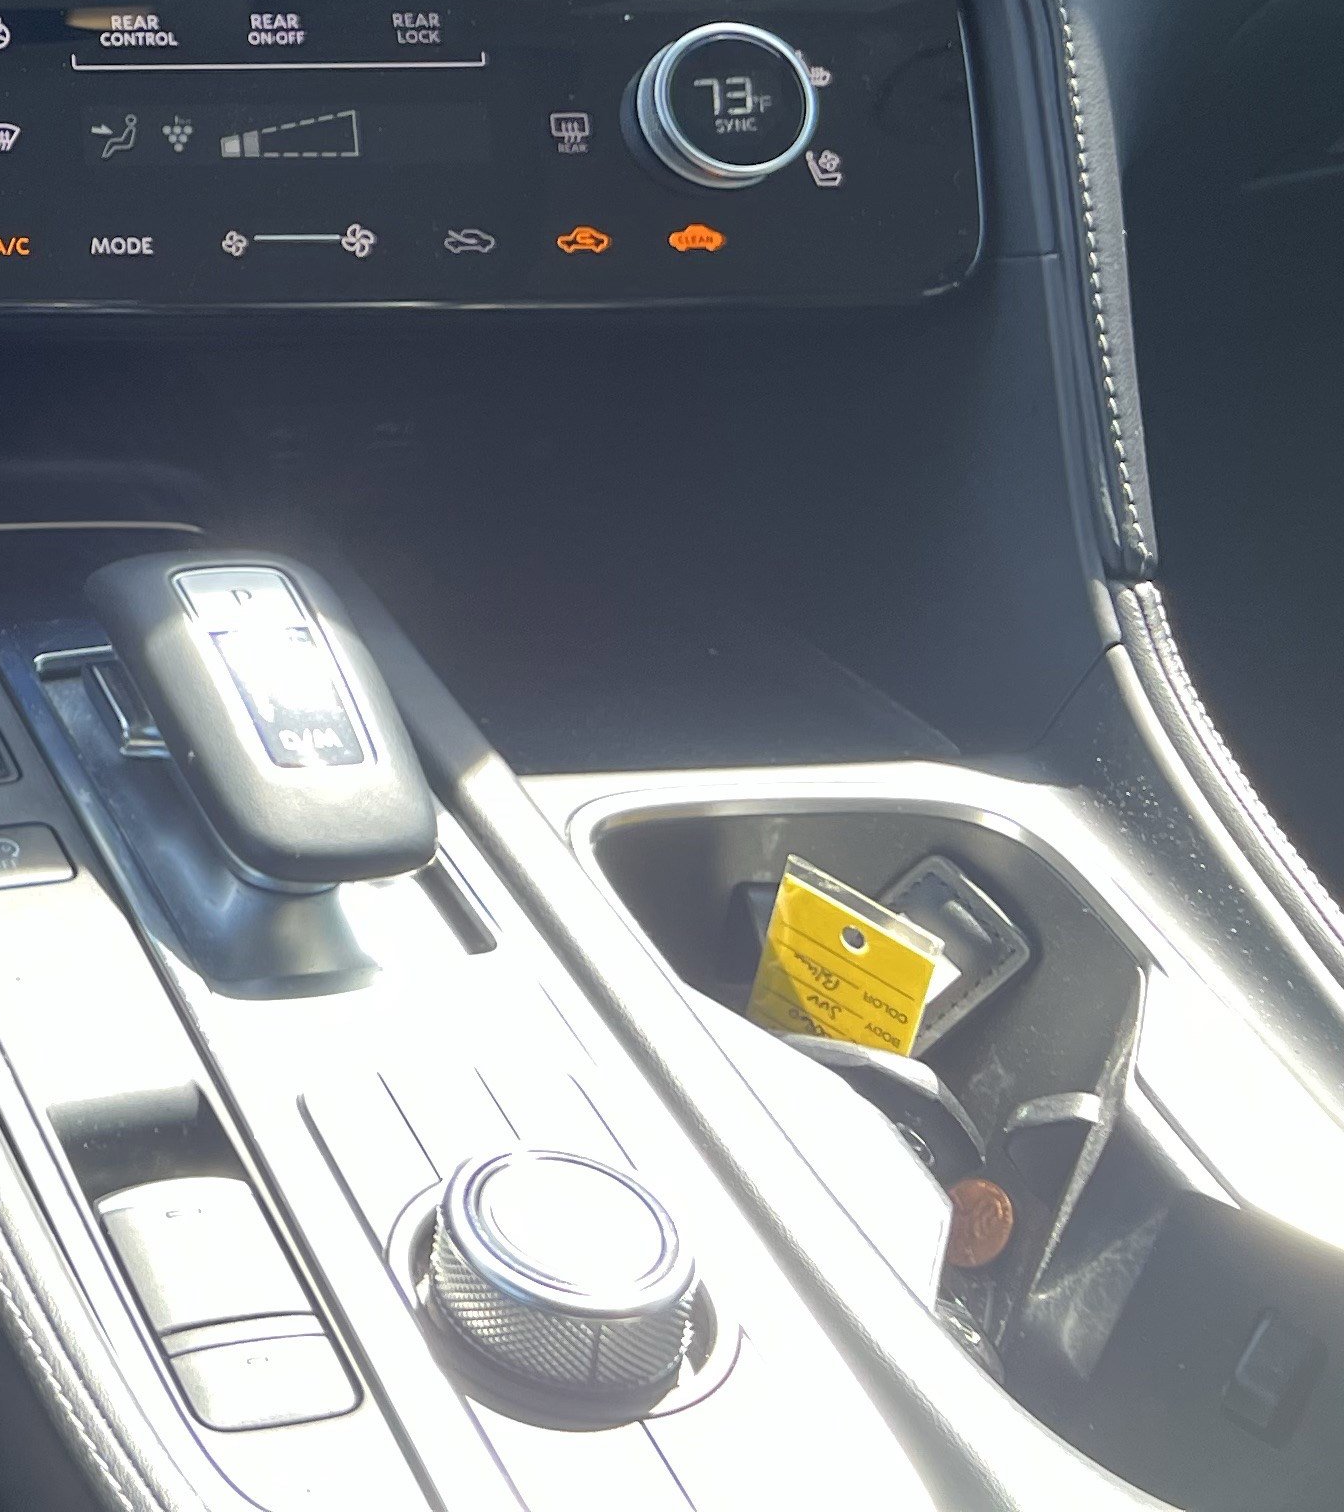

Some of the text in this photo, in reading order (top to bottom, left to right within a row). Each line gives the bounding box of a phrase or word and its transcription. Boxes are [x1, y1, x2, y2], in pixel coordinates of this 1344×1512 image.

[111, 15, 159, 31] REAR
[250, 13, 299, 30] REAR
[392, 13, 441, 29] REAR
[100, 31, 178, 47] CONTROL
[397, 29, 441, 44] LOCK
[715, 118, 758, 134] SYNC
[90, 237, 154, 255] MODE
[863, 990, 908, 1025] COLOR
[865, 1022, 901, 1049] BODY
